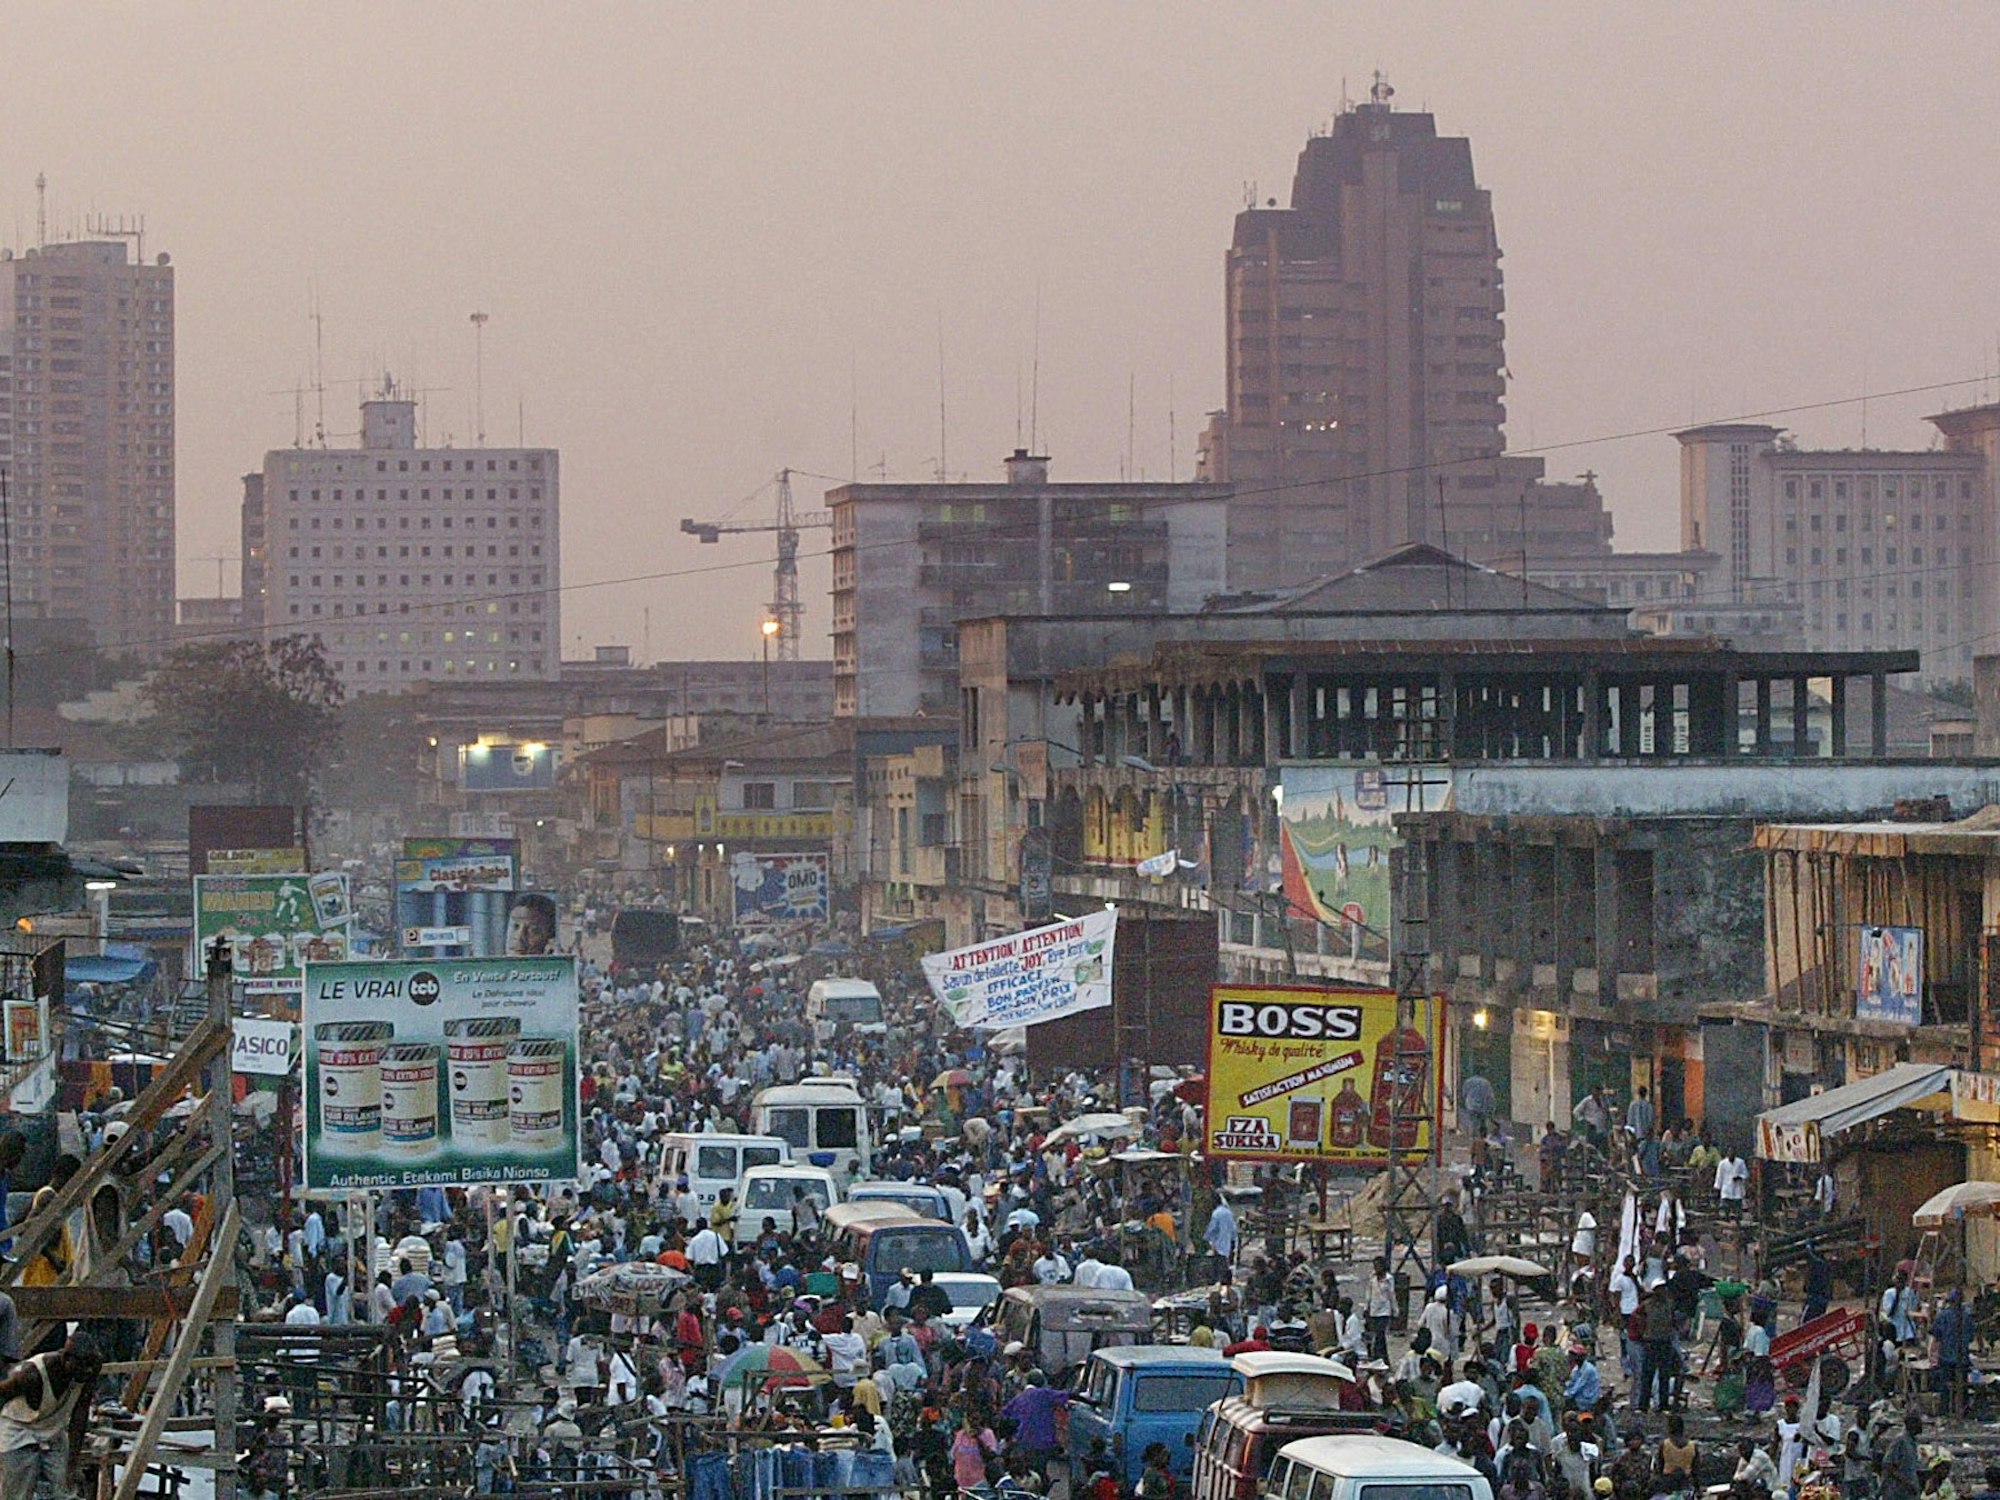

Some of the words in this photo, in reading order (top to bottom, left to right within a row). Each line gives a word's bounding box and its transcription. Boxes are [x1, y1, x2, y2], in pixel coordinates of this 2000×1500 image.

[788, 870, 818, 889] OMO
[454, 971, 470, 984] En
[319, 981, 346, 1000] LE
[354, 979, 403, 999] VRAI
[410, 978, 439, 995] tcb
[1221, 1003, 1360, 1038] BOSS
[231, 1035, 288, 1056] ASICO
[1221, 1038, 1266, 1062] Whisky
[1268, 1041, 1281, 1057] de
[1282, 1041, 1324, 1063] qualité
[1242, 1073, 1306, 1107] SATISFACTION
[1229, 1119, 1265, 1134] EZA
[1212, 1134, 1277, 1149] SUKISA
[330, 1173, 397, 1187] Authentic
[402, 1169, 457, 1185] Etekami
[461, 1167, 501, 1181] Bisika
[502, 1165, 550, 1179] Nionso
